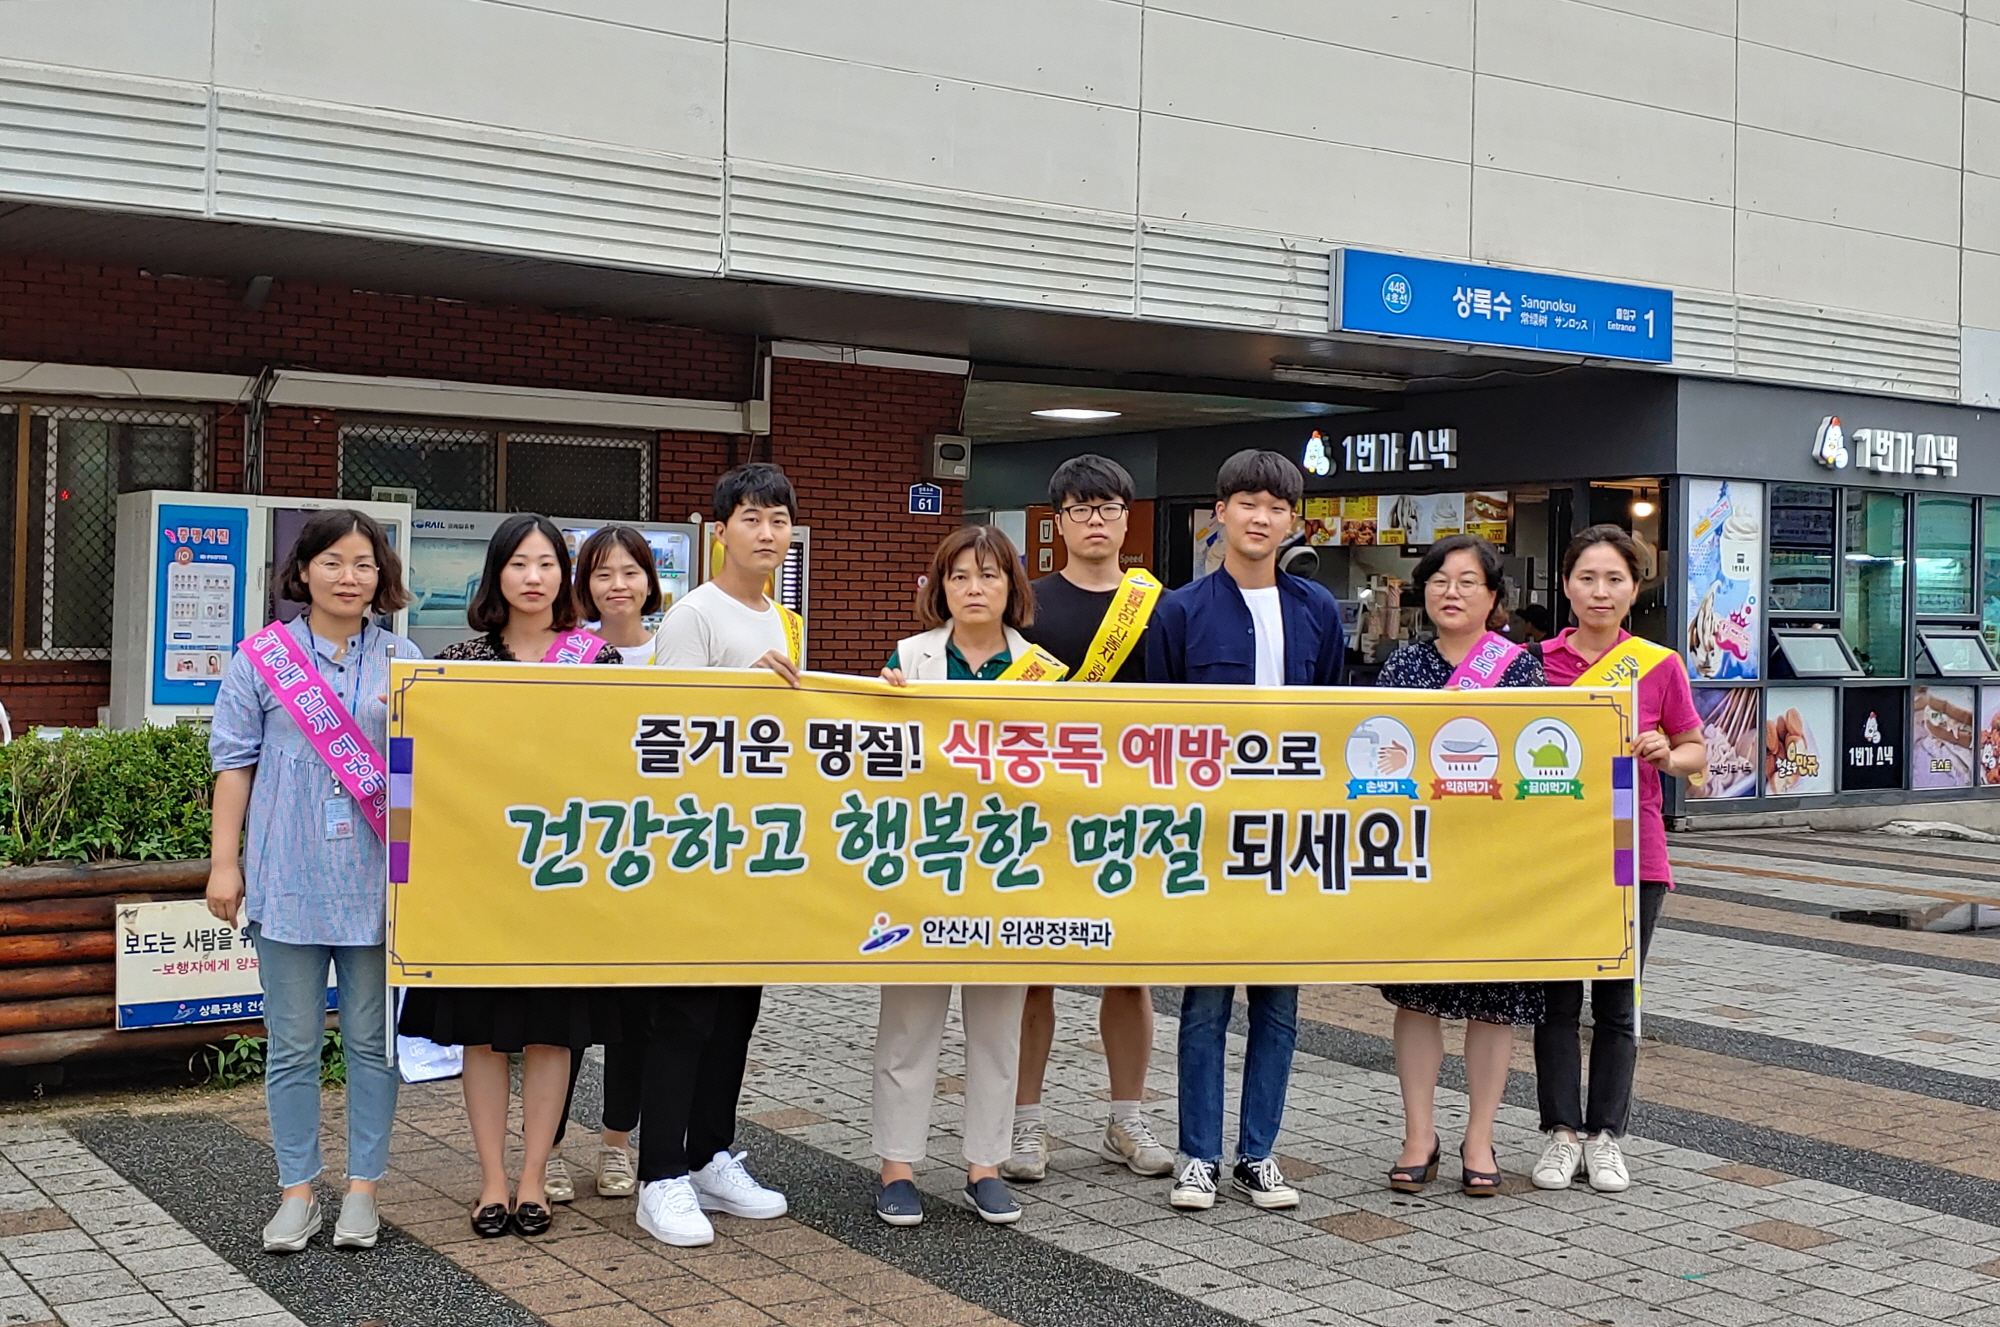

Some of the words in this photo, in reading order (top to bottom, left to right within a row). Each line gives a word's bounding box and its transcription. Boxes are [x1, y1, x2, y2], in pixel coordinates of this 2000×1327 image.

[1388, 281, 1406, 294] 448
[1385, 293, 1408, 305] 4호선
[1452, 286, 1512, 321] 상록수
[1521, 295, 1576, 314] Sangnoksu
[1607, 320, 1637, 333] Entrance
[1643, 309, 1655, 339] 1
[1342, 431, 1405, 473] 1번가
[1408, 428, 1457, 471] 스낵
[1852, 429, 1914, 475] 1번가
[1914, 434, 1958, 478] 스낵
[918, 498, 932, 511] 61
[177, 527, 230, 545] 증명사진
[1119, 552, 1144, 565] Speed
[1099, 624, 1129, 664] 자동차
[253, 632, 307, 689] 식중독
[294, 686, 341, 733] 함께
[635, 717, 790, 775] 즐거운
[809, 722, 923, 777] 명절!
[943, 723, 1103, 784] 식중독
[1122, 726, 1322, 787] 예방으로
[1849, 748, 1874, 767] 1번가
[1875, 745, 1894, 766] 스낵
[1930, 759, 1952, 772] 토스트
[1365, 778, 1400, 794] 손씻기
[508, 798, 806, 888] 건강하고
[835, 794, 1048, 893] 행복한
[1071, 806, 1206, 894] 명절
[1226, 810, 1430, 892] 되세요!
[124, 931, 177, 955] 보도는
[182, 927, 234, 953] 사람을
[922, 919, 991, 946] 안산시
[1000, 920, 1112, 947] 위생정책과
[198, 1001, 243, 1018] 상록구청
